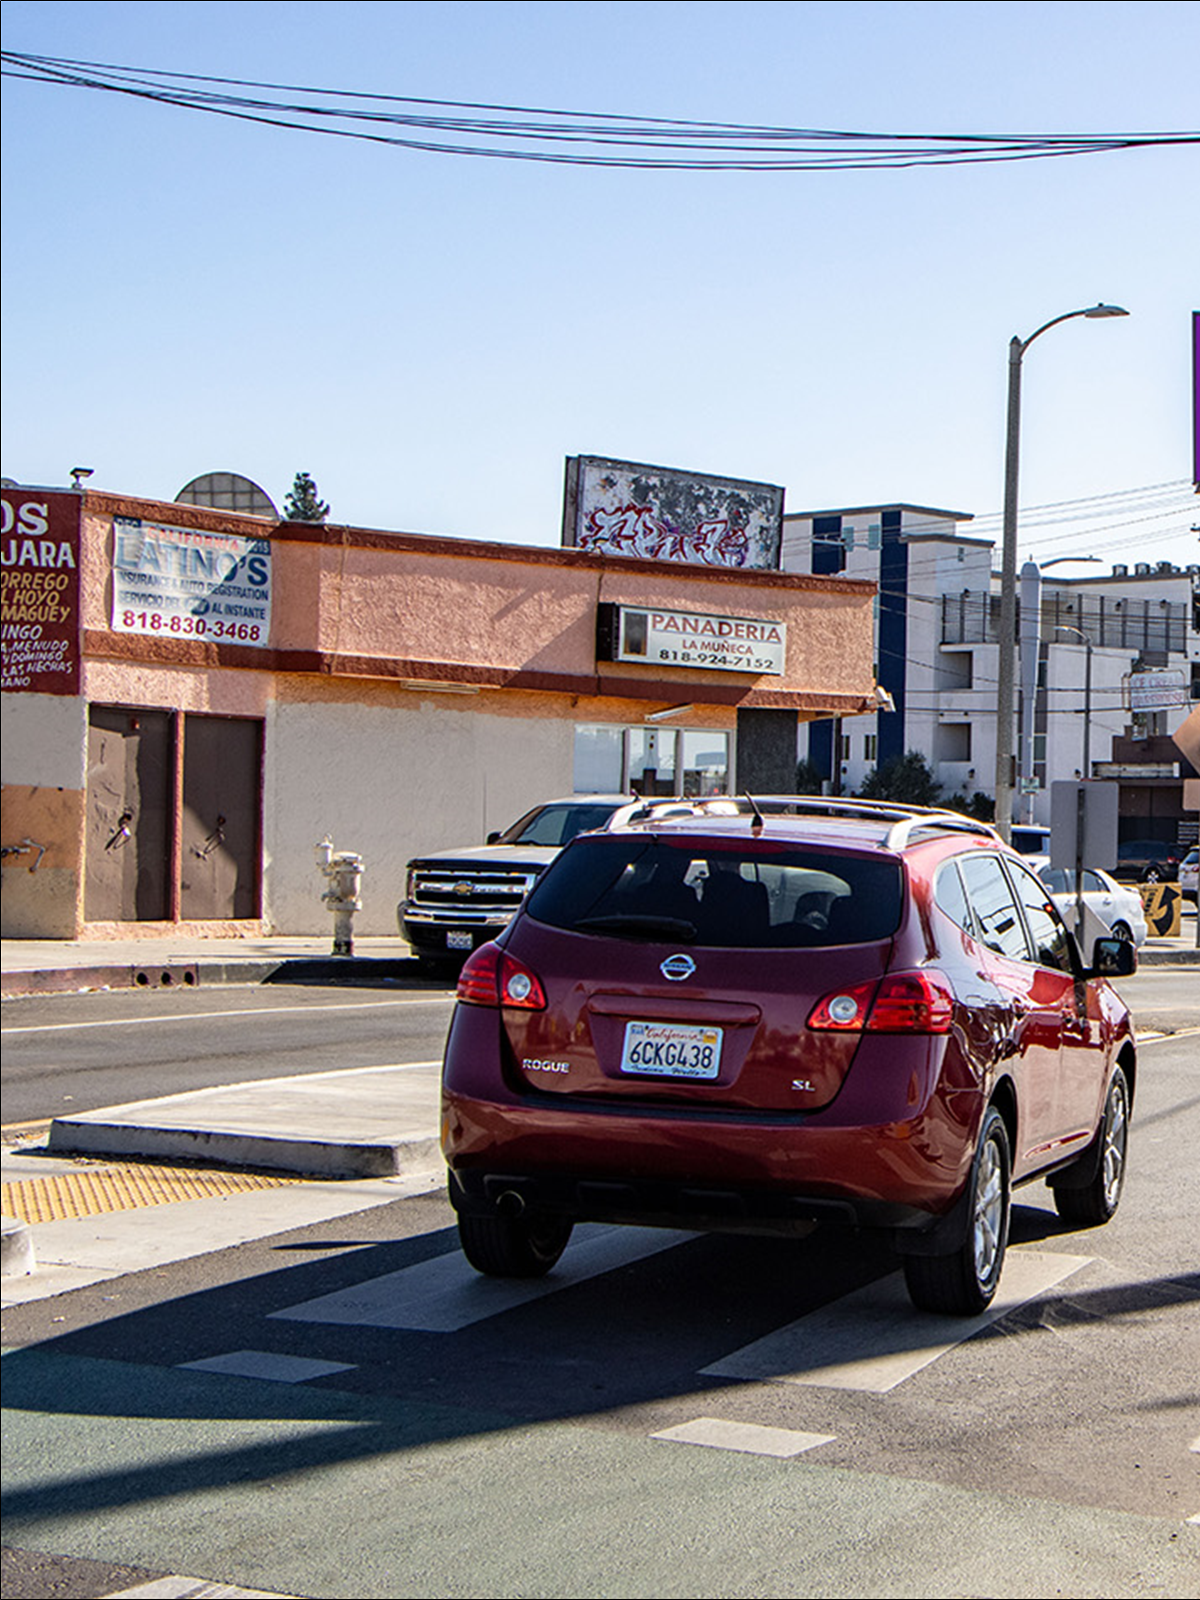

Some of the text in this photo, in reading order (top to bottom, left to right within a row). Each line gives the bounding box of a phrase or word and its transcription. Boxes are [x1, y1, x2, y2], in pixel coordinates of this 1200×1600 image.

[117, 536, 268, 586] LATINO'S
[13, 590, 60, 606] HOYO
[207, 583, 269, 601] REGISTRATION
[1, 605, 71, 623] MAGUEY
[224, 603, 266, 620] INSTANTE
[122, 609, 261, 642] 818-830-3468
[651, 613, 782, 643] PANADERIA
[12, 640, 69, 651] MENUDO
[682, 639, 755, 656] LA MUÑECA
[10, 651, 63, 663] DOMINGO
[659, 649, 774, 669] 818-924-7152
[1, 660, 73, 678] LAS HECHAS
[646, 1027, 699, 1042] California
[629, 1041, 714, 1069] 6CKG438
[522, 1057, 570, 1074] ROGUE
[791, 1079, 816, 1092] SL
